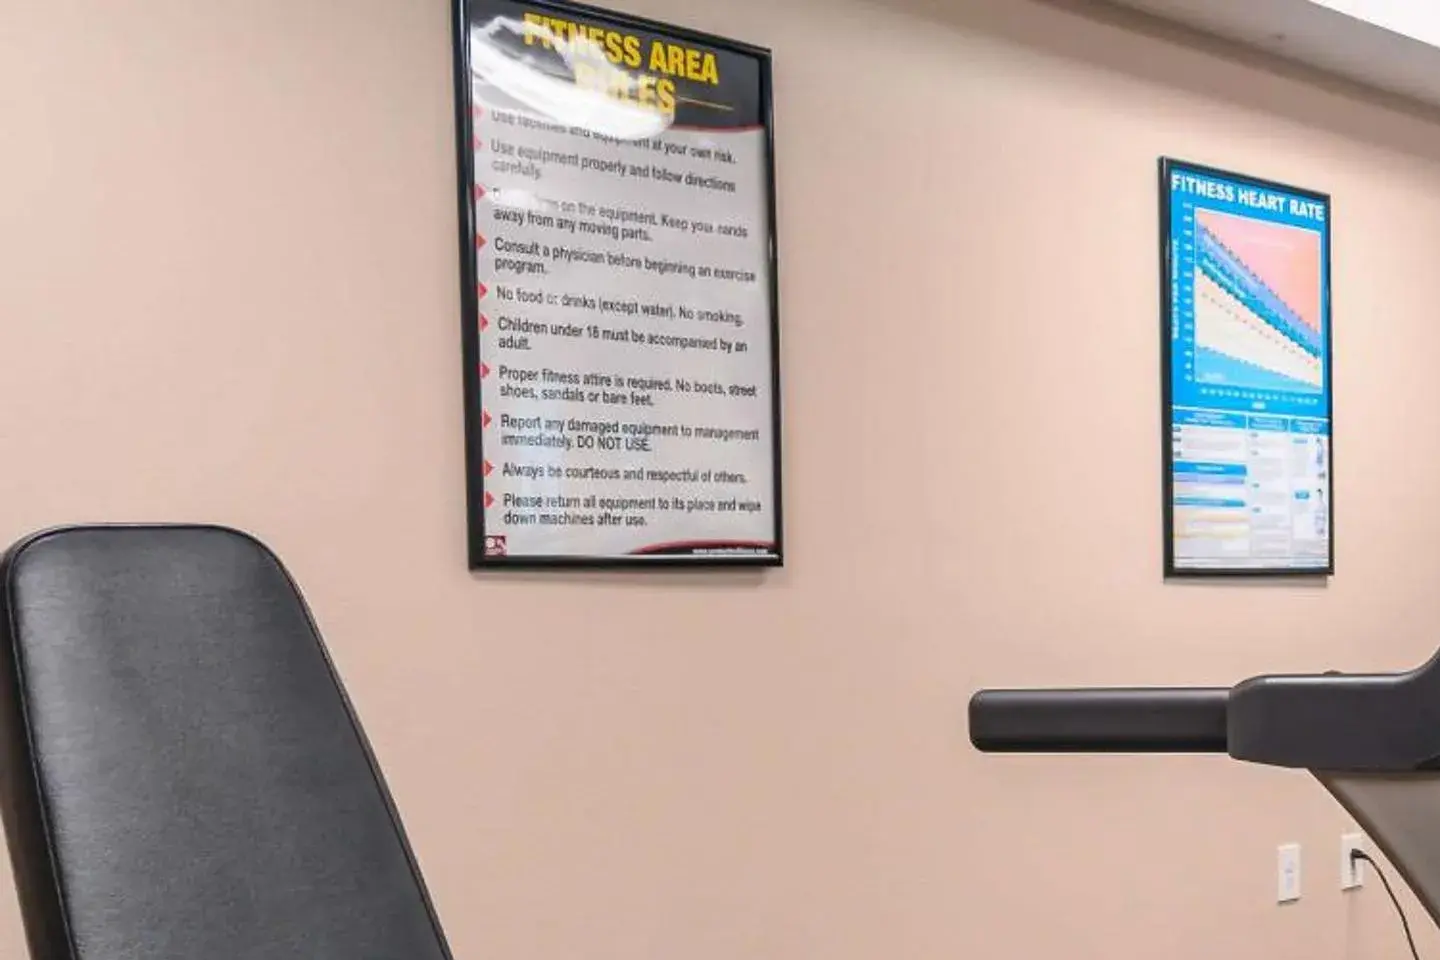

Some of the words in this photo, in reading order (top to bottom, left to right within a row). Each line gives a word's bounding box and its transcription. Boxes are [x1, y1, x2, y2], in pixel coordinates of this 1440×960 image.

[524, 12, 642, 68] FITNESS
[650, 40, 719, 87] AREA
[575, 62, 677, 115] RLES
[491, 109, 515, 126] Use
[652, 140, 662, 151] at
[664, 142, 687, 156] your
[690, 147, 711, 159] own
[490, 138, 515, 156] Use
[518, 146, 579, 166] equipment
[581, 156, 626, 177] properly
[630, 165, 649, 178] and
[652, 165, 682, 183] follow
[685, 171, 736, 193] directions
[1171, 174, 1234, 202] FITNESS
[1238, 187, 1286, 212] HEART
[1289, 199, 1326, 221] RATE
[493, 209, 524, 226] away
[527, 210, 554, 228] from
[556, 218, 576, 233] any
[579, 221, 619, 240] moving
[578, 202, 595, 216] the
[661, 214, 688, 230] Keep
[691, 221, 713, 234] your
[494, 237, 540, 256] Consult
[543, 245, 550, 257] a
[552, 245, 605, 263] physician
[607, 251, 642, 268] before
[645, 256, 695, 280] beginning
[698, 267, 711, 277] an
[714, 267, 755, 282] exercise
[497, 285, 513, 300] No
[516, 287, 543, 304] food
[561, 294, 596, 309] drinks
[679, 306, 694, 320] No
[498, 316, 548, 334] Children
[550, 323, 583, 337] under
[602, 328, 629, 341] must
[631, 330, 645, 343] be
[648, 334, 717, 350] accompanied
[720, 338, 732, 354] by
[735, 342, 748, 352] an
[499, 365, 539, 383] Proper
[542, 368, 580, 385] fitness
[583, 373, 612, 387] attire
[614, 374, 624, 387] is
[675, 378, 691, 392] No
[729, 384, 756, 397] street
[541, 388, 585, 402] sandals
[587, 391, 599, 402] or
[602, 391, 627, 404] bare
[500, 413, 541, 430] Report
[545, 419, 565, 433] any
[567, 418, 619, 434] damaged
[621, 423, 679, 436] equipment
[681, 425, 692, 437] to
[694, 427, 759, 441] management
[577, 435, 594, 449] DO
[598, 436, 622, 450] NOT
[502, 462, 544, 479] Always
[548, 464, 562, 477] be
[565, 466, 620, 479] courteous
[623, 467, 643, 480] and
[647, 467, 699, 484] respectful
[701, 469, 711, 482] of
[503, 493, 542, 507] Please
[546, 494, 580, 508] return
[583, 494, 596, 508] all
[599, 498, 655, 511] equipment
[658, 497, 669, 510] to
[672, 497, 685, 510] its
[687, 498, 715, 514] place
[718, 497, 736, 511] and
[738, 501, 761, 513] wipe
[504, 511, 536, 525] down
[540, 511, 594, 525] machines
[597, 512, 622, 526] after
